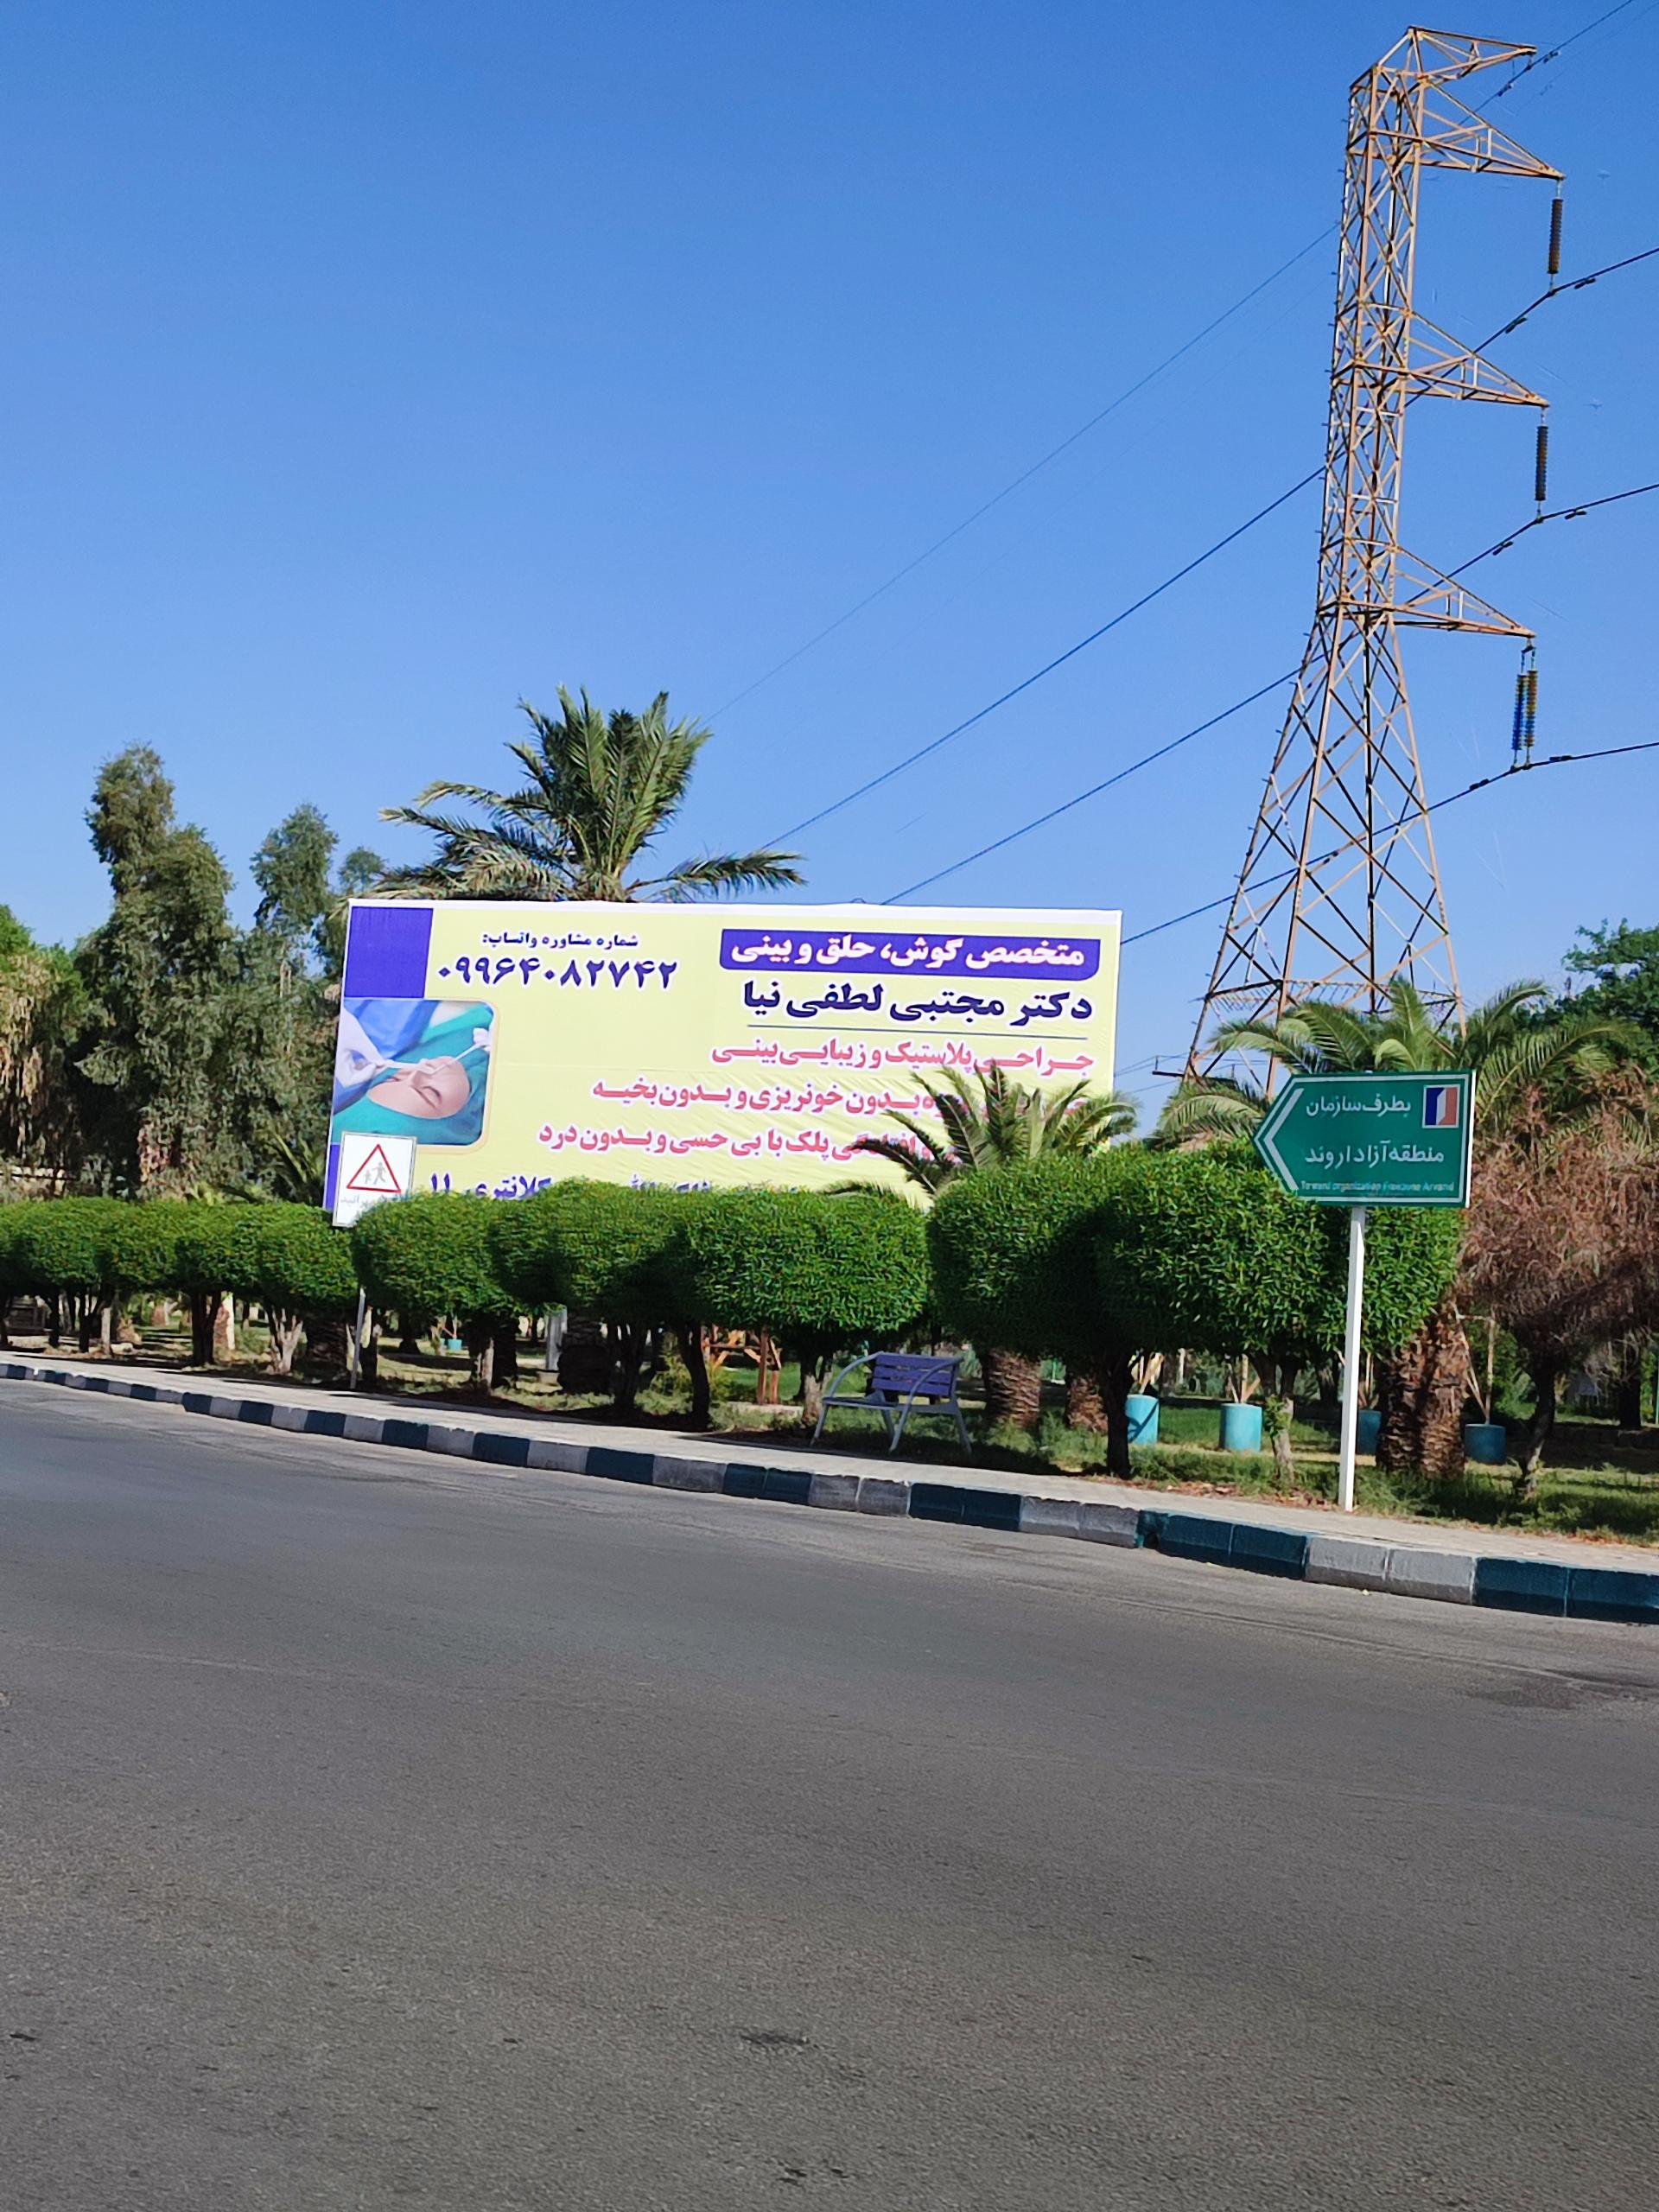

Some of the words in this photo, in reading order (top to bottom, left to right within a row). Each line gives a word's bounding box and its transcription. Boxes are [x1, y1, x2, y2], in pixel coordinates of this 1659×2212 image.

[543, 933, 592, 949] مشاوره
[597, 934, 639, 950] شماره
[732, 935, 792, 963] بینی
[795, 943, 810, 963] و
[816, 934, 876, 965] حلق
[967, 939, 1084, 969] متخصص
[438, 957, 677, 989] ۰۹۹۶۴۰۸۲۷۴۲
[743, 979, 780, 1015] نیا
[786, 982, 883, 1018] لطفی
[890, 988, 1005, 1023] مجتبی
[1010, 990, 1092, 1026] دکتر
[712, 1039, 777, 1067] بینی
[779, 1039, 867, 1069] زیبایی
[870, 1049, 881, 1069] و
[885, 1040, 972, 1073] پلاستیک
[593, 1077, 658, 1106] بخیه
[659, 1084, 732, 1109] بدون
[734, 1092, 747, 1111] و
[749, 1084, 843, 1115] خونریزی
[844, 1092, 920, 1116] بدون
[1306, 1094, 1363, 1119] سازمان
[1363, 1092, 1412, 1119] بطرف
[538, 1123, 577, 1150] درد
[580, 1128, 652, 1154] بدون
[653, 1134, 667, 1154] و
[669, 1129, 728, 1154] حسی
[731, 1133, 762, 1156] بی
[767, 1128, 783, 1160] با
[787, 1129, 830, 1161] پلک
[1304, 1146, 1351, 1170] اروند
[1353, 1139, 1392, 1169] آزاد
[1388, 1143, 1446, 1163] منطقه
